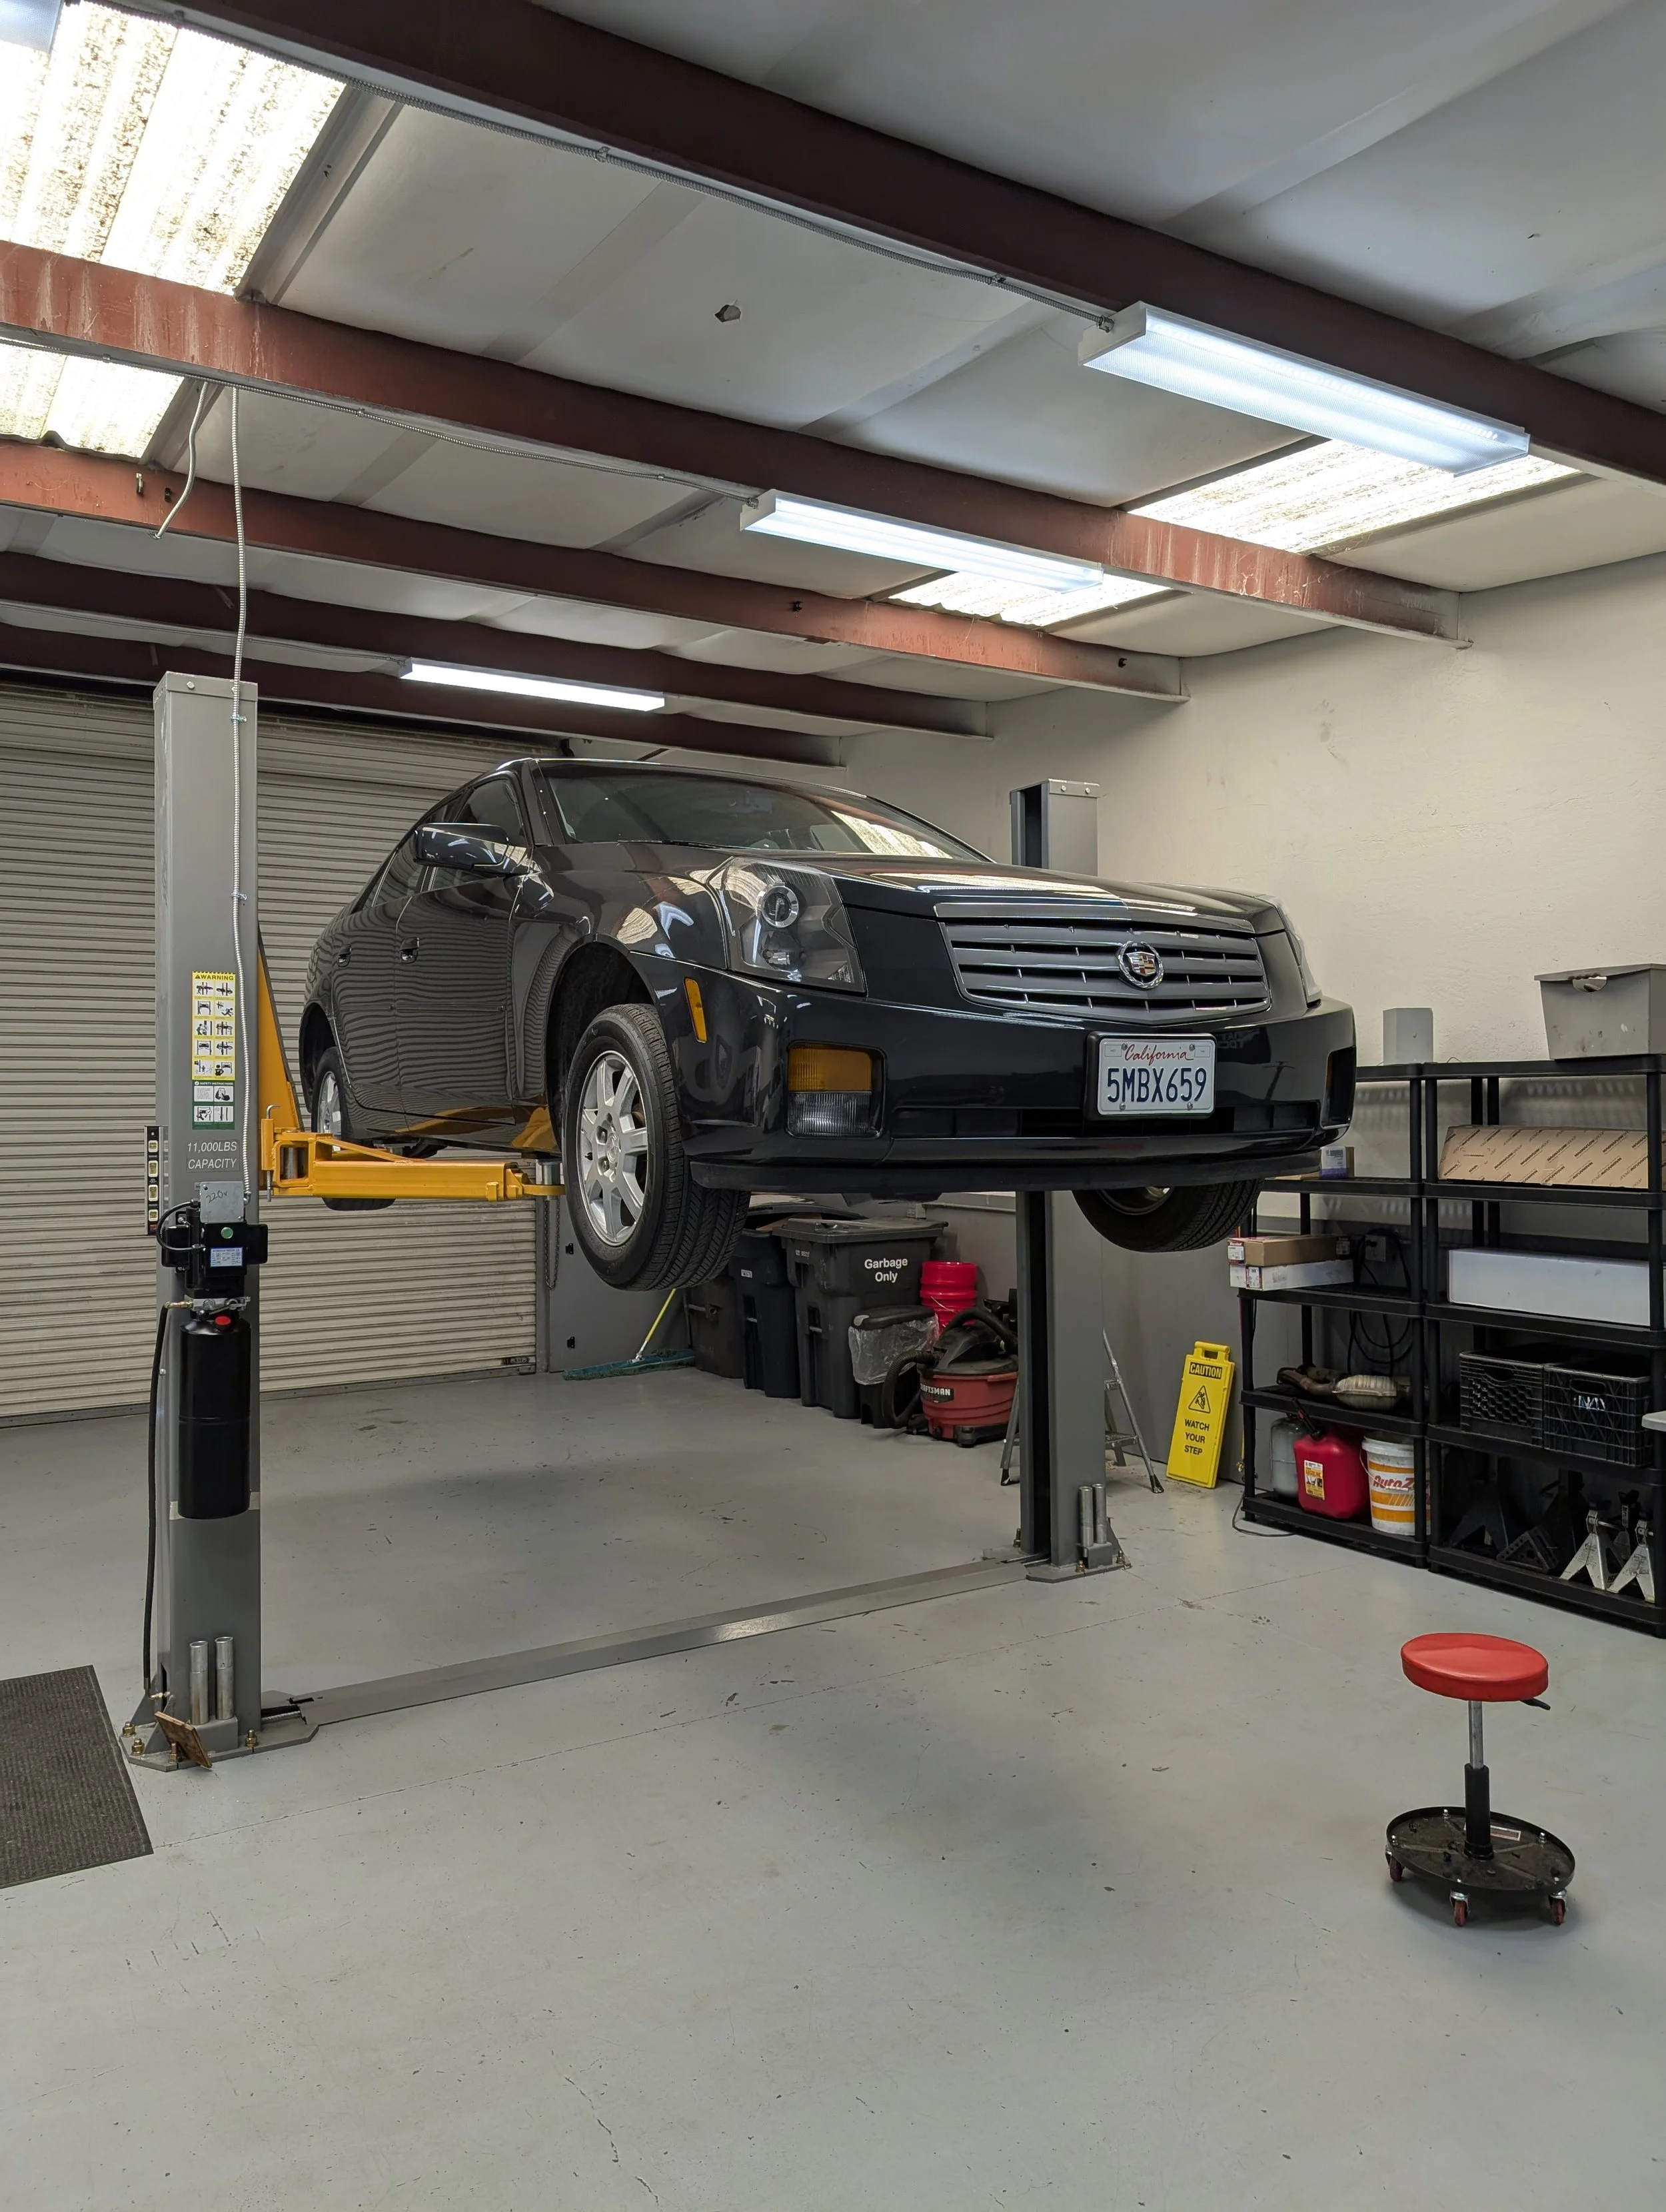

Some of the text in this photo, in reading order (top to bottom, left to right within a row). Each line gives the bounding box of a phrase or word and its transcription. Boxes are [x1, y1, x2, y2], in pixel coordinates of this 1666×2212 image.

[1124, 1043, 1194, 1066] California
[1107, 1067, 1207, 1103] 5MBX659
[187, 1141, 237, 1153] 11,000LBS
[188, 1158, 237, 1169] CAPACITY
[864, 1257, 908, 1270] Garbage
[874, 1271, 898, 1283] Only
[1190, 1363, 1222, 1379] CAUTION
[920, 1382, 950, 1396] RAFTSMAN
[1184, 1418, 1210, 1431] WATCH
[1186, 1432, 1206, 1444] YOUR
[1184, 1445, 1202, 1455] STEP
[1373, 1475, 1415, 1489] AutoZ
